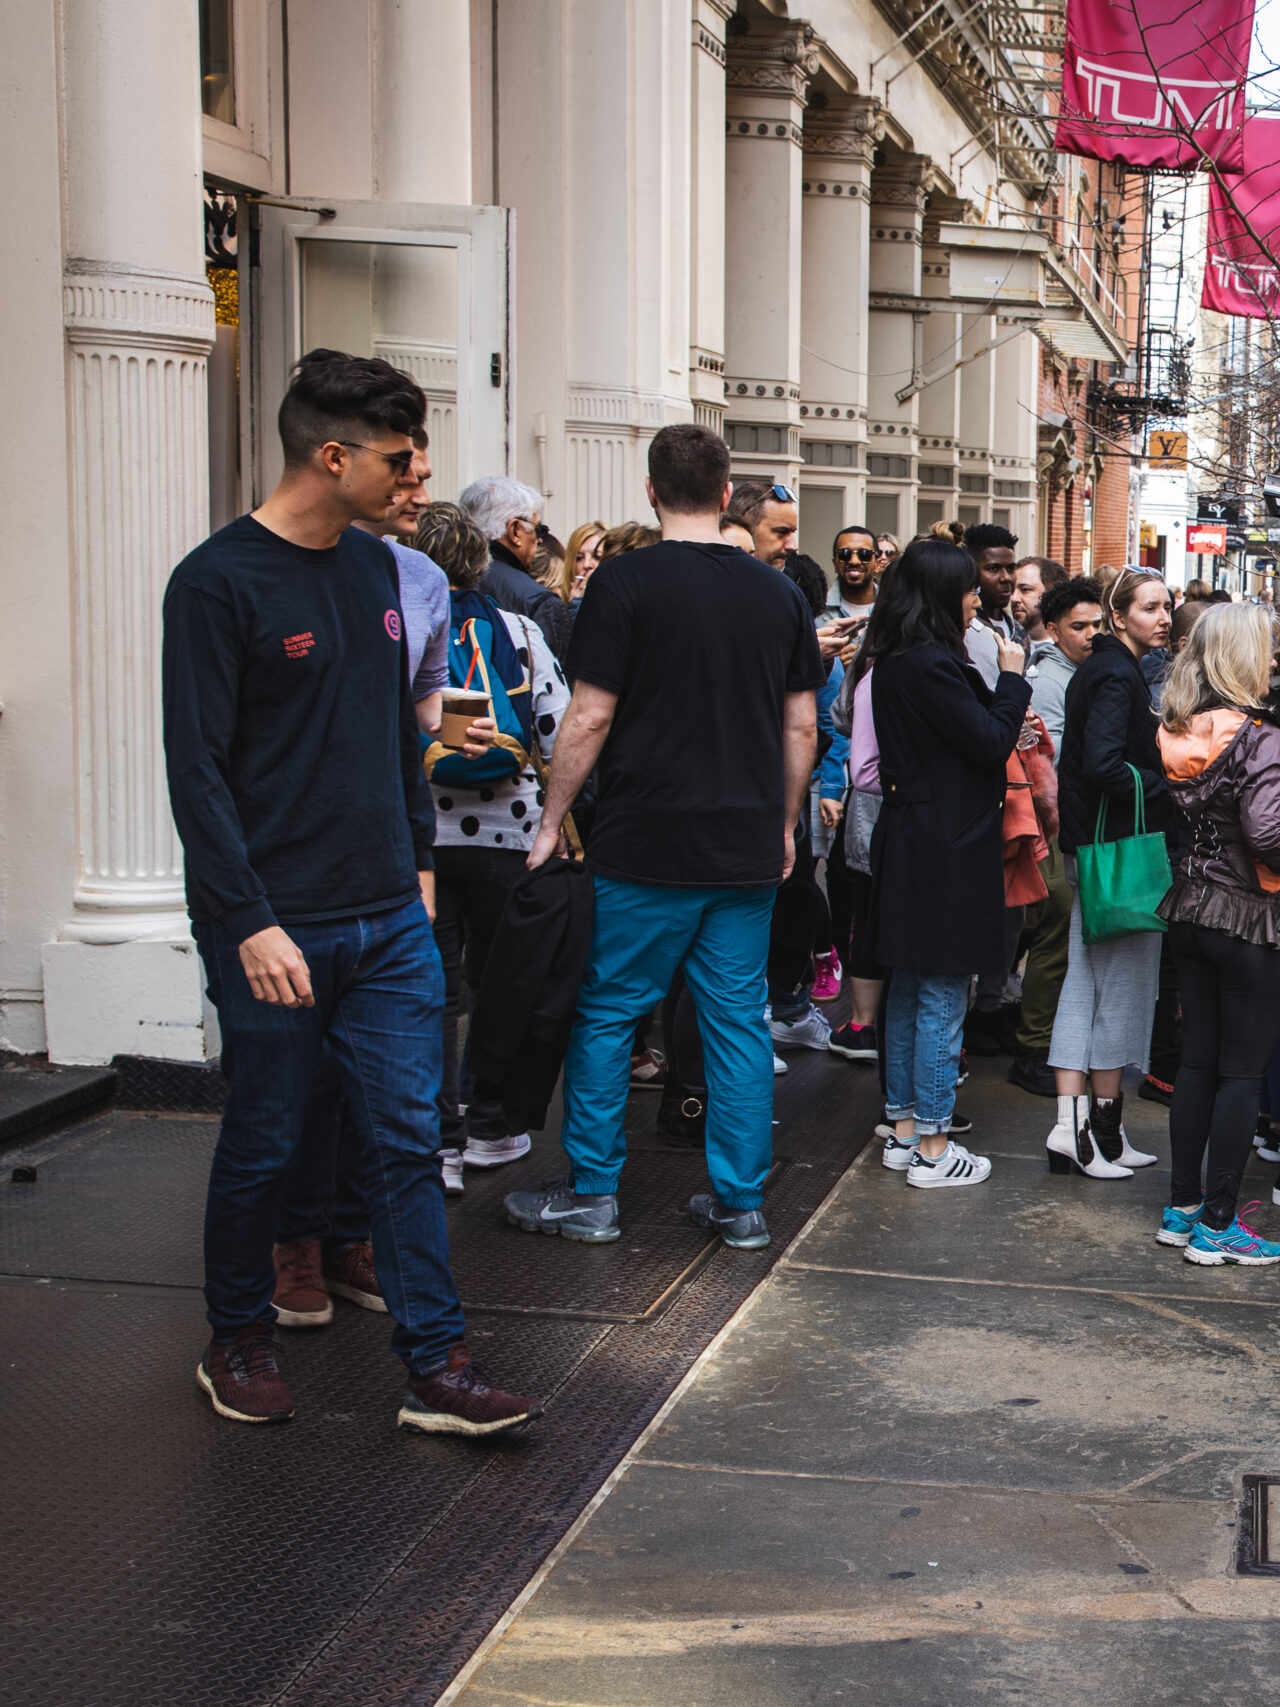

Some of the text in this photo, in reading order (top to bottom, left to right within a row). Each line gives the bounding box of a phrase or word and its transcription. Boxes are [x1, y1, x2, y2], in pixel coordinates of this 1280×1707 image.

[1076, 57, 1236, 130] TUMI
[283, 631, 314, 645] SUMMER
[285, 639, 316, 652] SIXTEEN
[286, 648, 309, 659] TOUR
